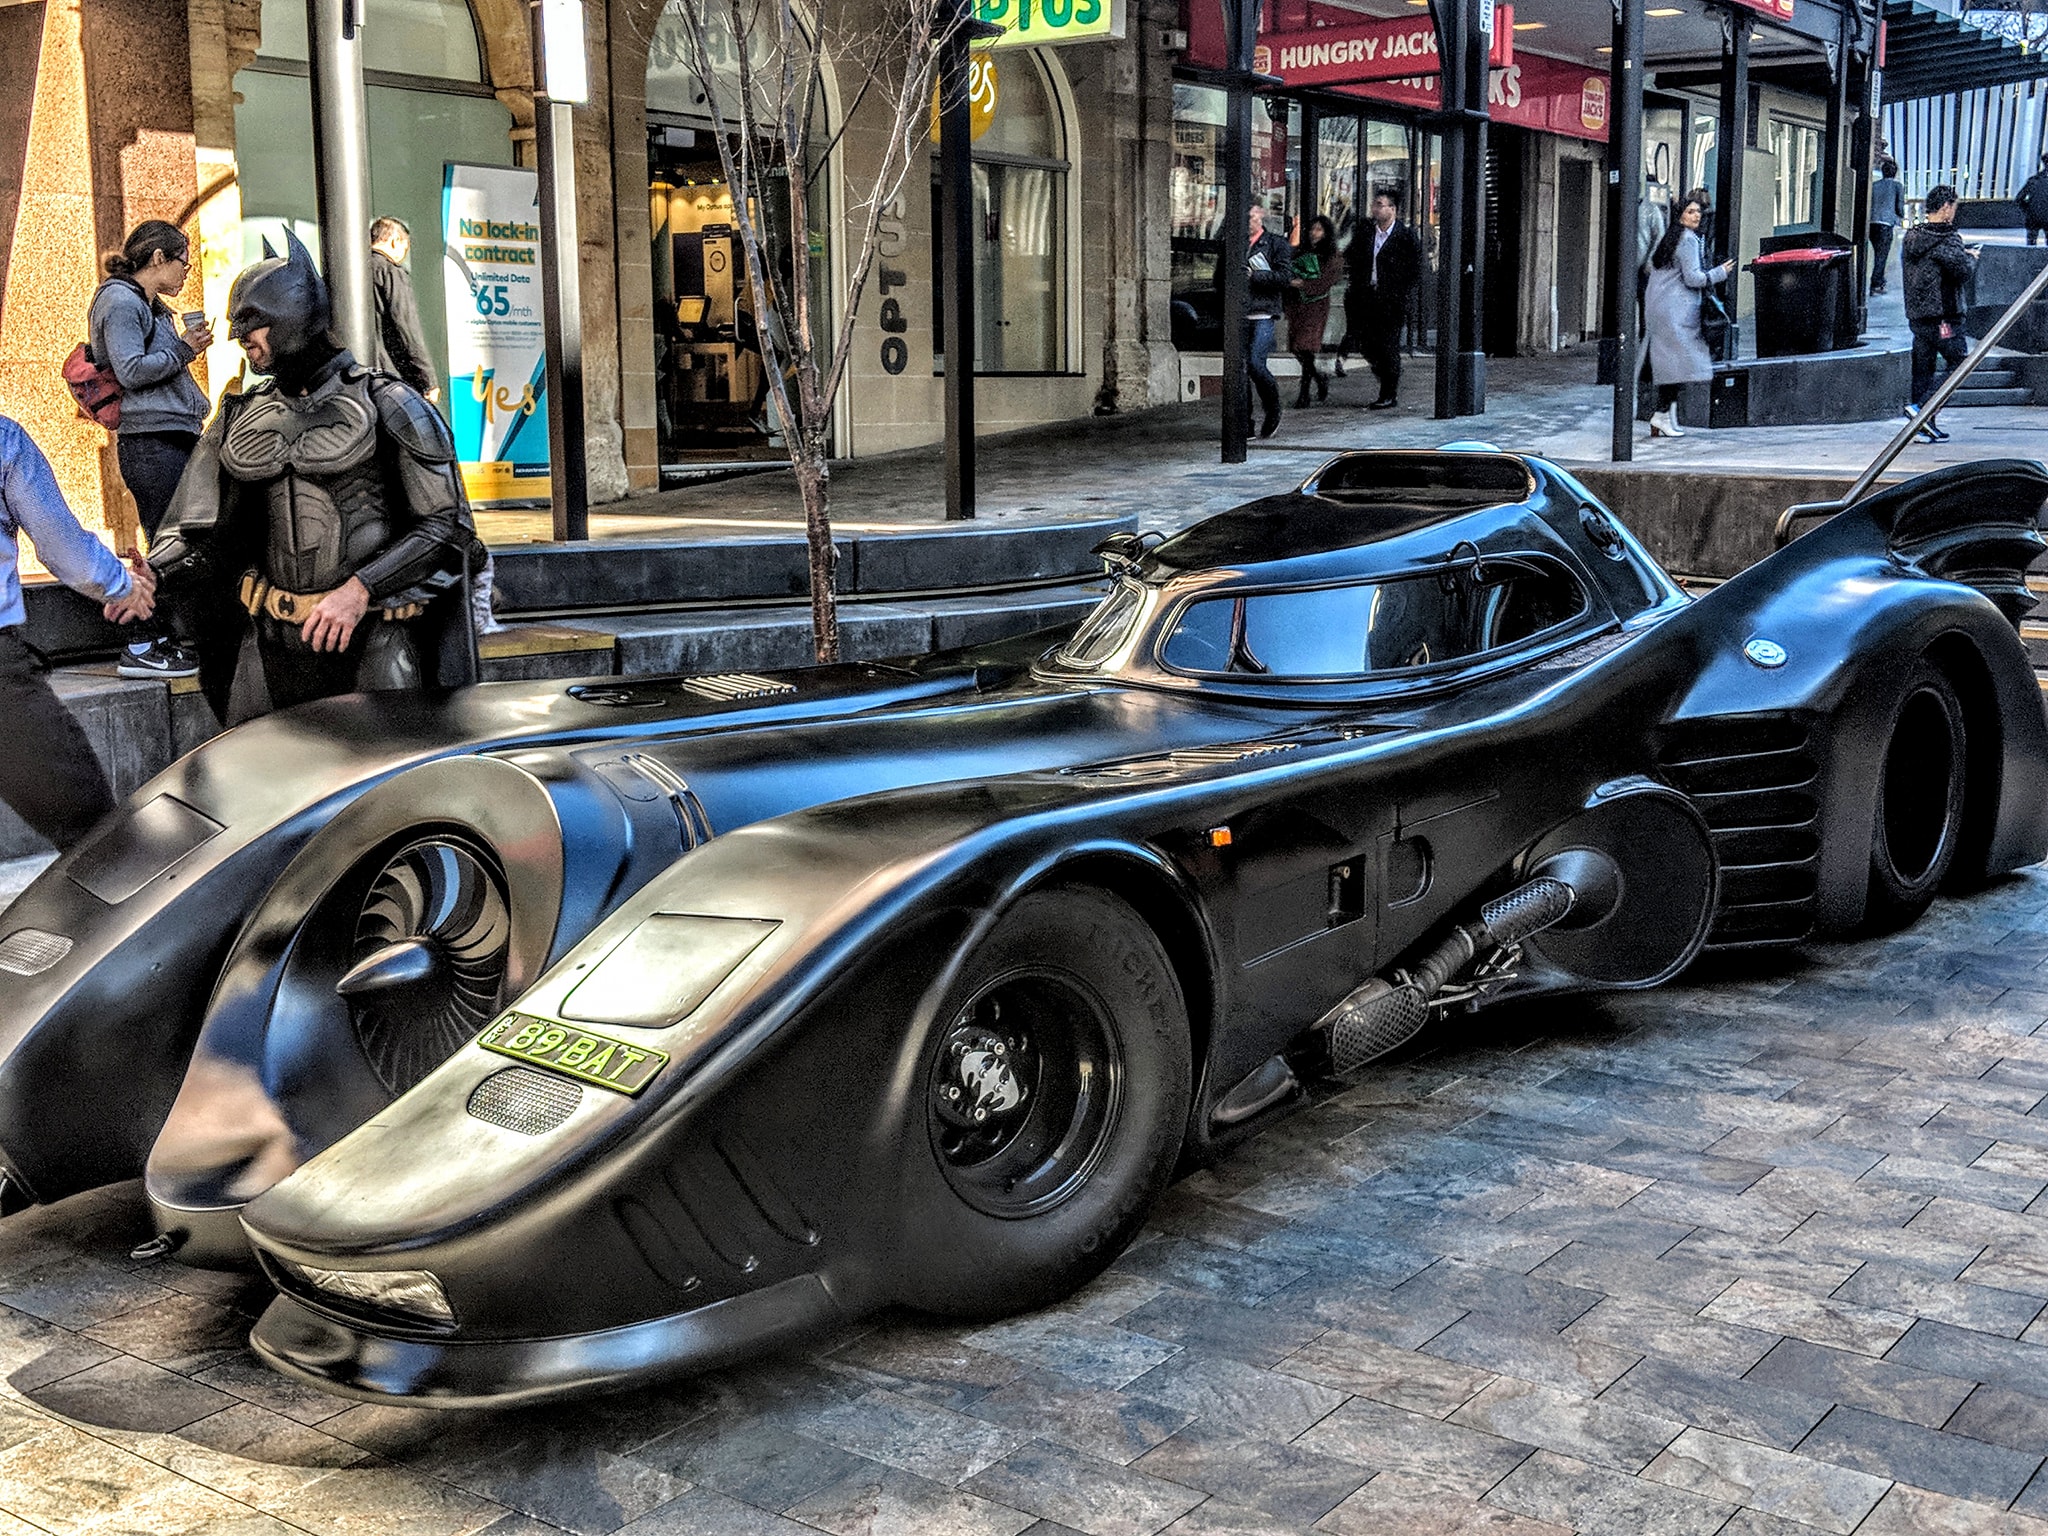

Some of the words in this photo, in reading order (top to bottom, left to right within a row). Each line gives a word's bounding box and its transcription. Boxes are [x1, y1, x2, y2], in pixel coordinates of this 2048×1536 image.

[971, 0, 1101, 31] PTUS
[1281, 37, 1379, 69] HUNGRY
[1382, 30, 1438, 59] JACK
[969, 61, 995, 113] es
[460, 218, 483, 236] No
[487, 219, 539, 240] lock-in
[465, 245, 535, 264] contract
[471, 272, 509, 282] Unlimited
[510, 273, 531, 284] Data
[472, 364, 536, 424] yes
